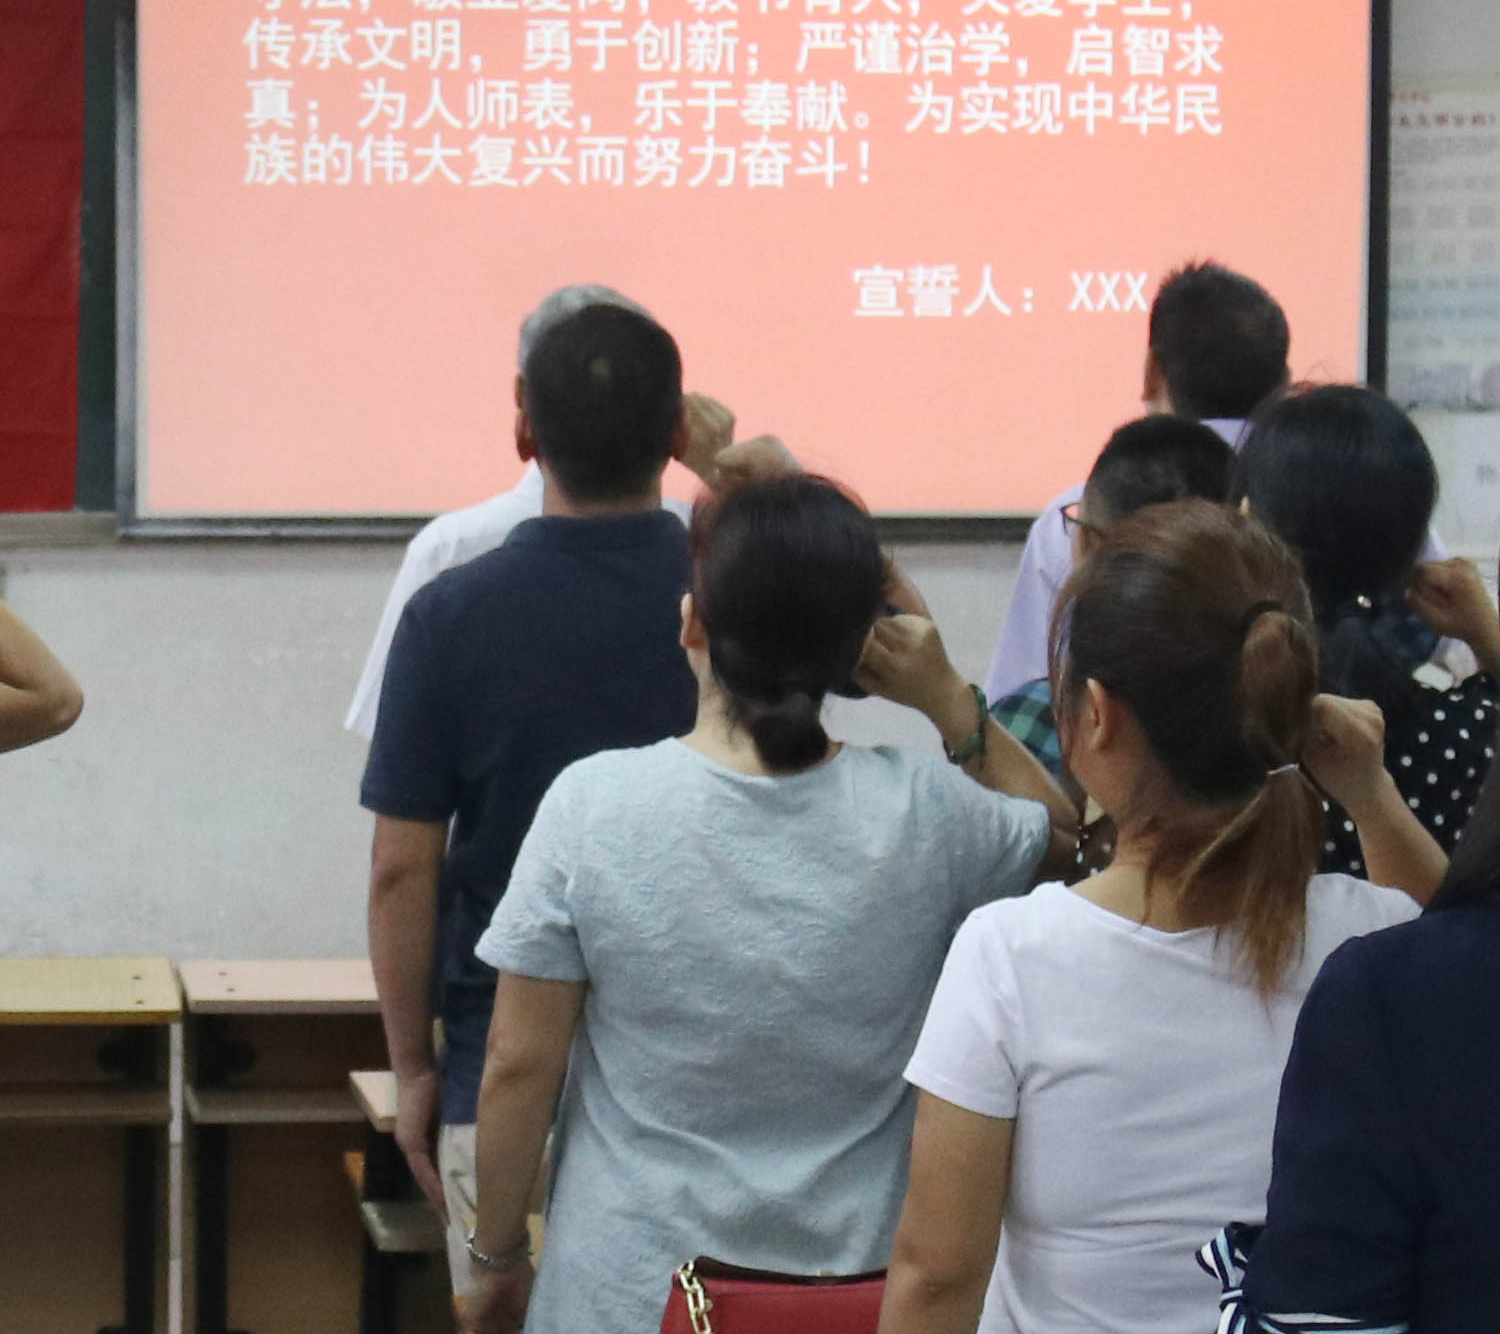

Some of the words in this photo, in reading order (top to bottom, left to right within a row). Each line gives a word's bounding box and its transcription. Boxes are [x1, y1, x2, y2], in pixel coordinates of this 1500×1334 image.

[243, 17, 1224, 77] 传承文明，勇于创新；严谨治学，启智求
[244, 78, 1223, 137] 真；为人师表，乐于奉献。为实现中华民
[243, 134, 870, 188] 族的伟大复兴而努力奋斗！
